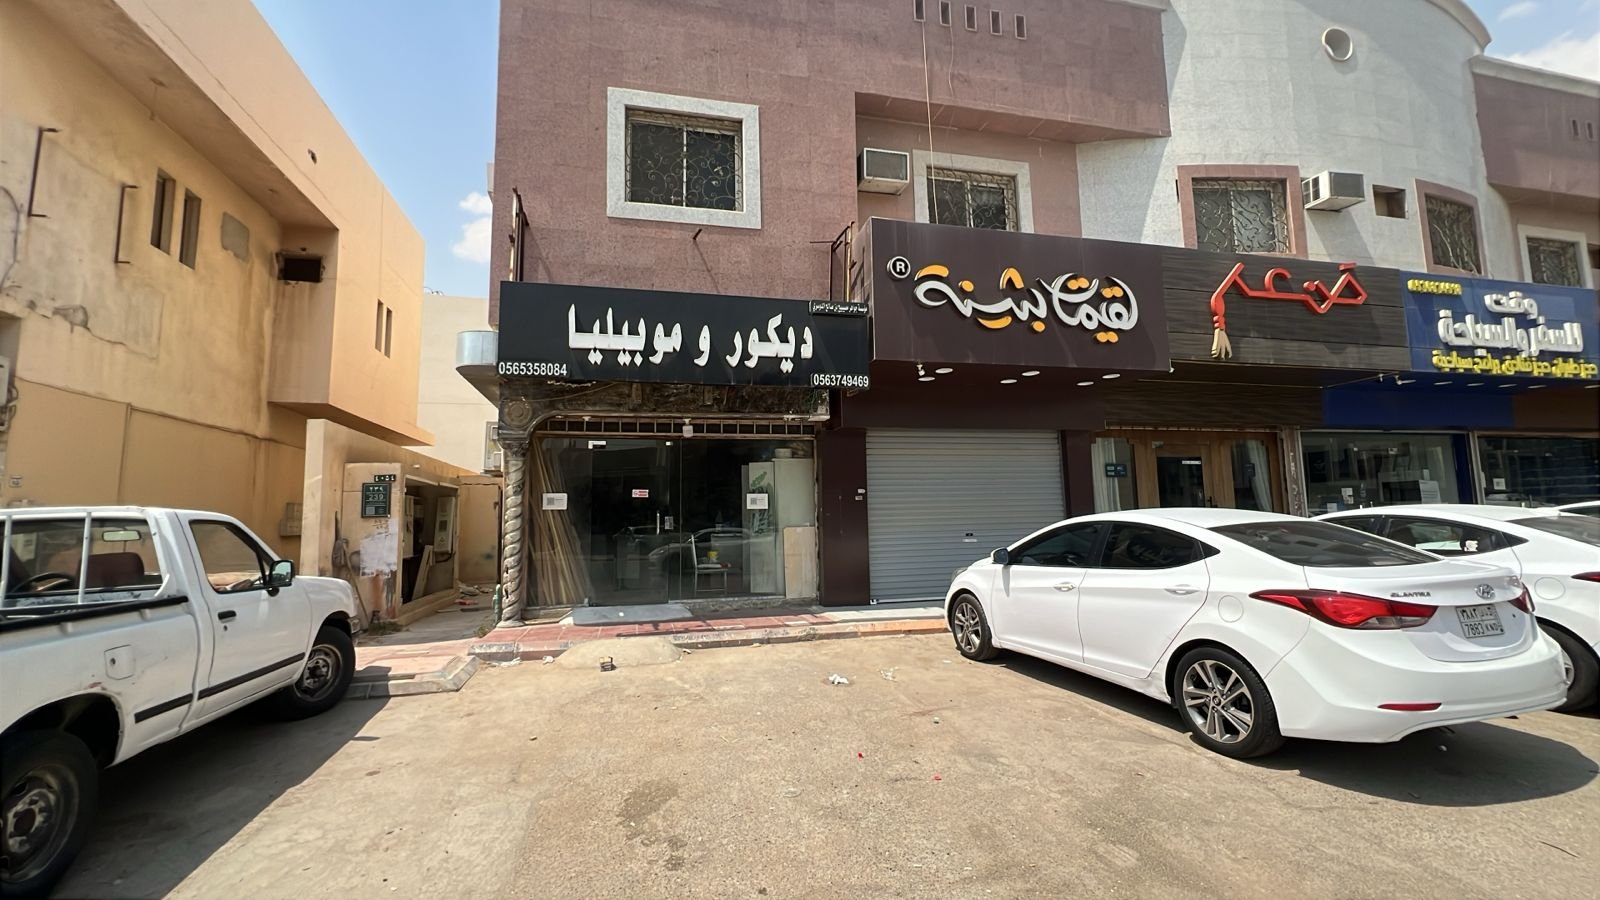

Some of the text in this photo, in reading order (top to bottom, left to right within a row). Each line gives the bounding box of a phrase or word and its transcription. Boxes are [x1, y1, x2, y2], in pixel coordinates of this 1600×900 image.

[567, 303, 813, 373] ديكور و موبيليا
[1437, 309, 1584, 358] للسفر والسياحة
[498, 361, 568, 377] 0565358084
[812, 373, 869, 388] 0563749469
[368, 493, 384, 501] 239
[1464, 623, 1485, 636] 7883
